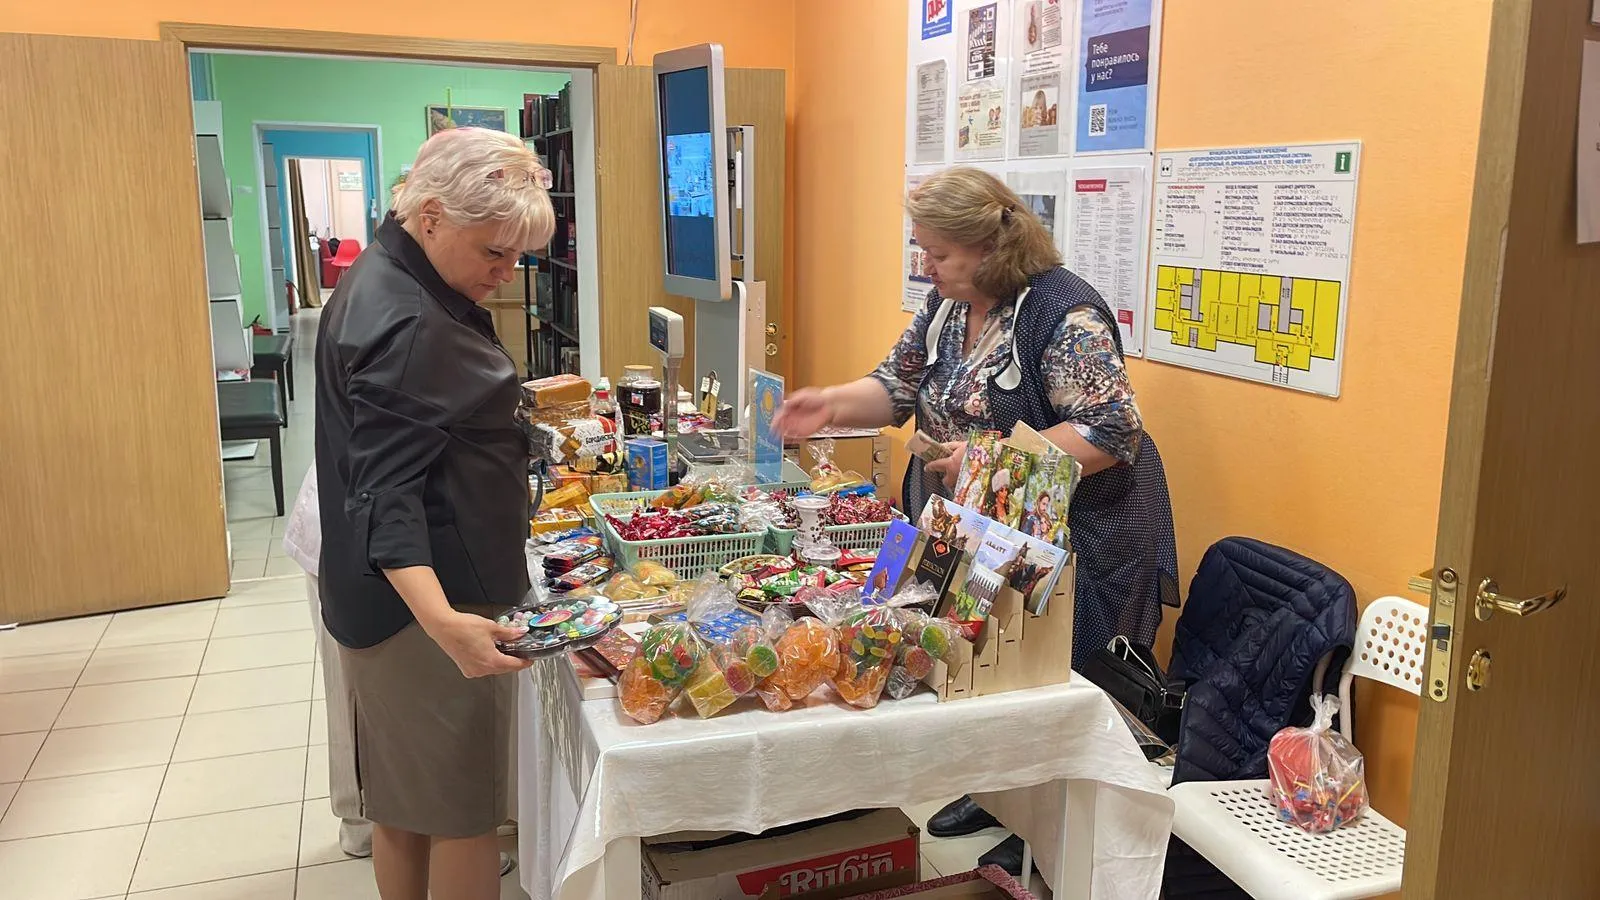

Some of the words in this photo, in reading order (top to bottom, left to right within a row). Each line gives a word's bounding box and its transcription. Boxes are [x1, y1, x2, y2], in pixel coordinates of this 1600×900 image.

[1092, 42, 1108, 55] Тебе
[1092, 53, 1140, 68] понравилось
[1091, 73, 1096, 84] у
[1096, 69, 1112, 80] нас?
[779, 852, 894, 896] Rubin
